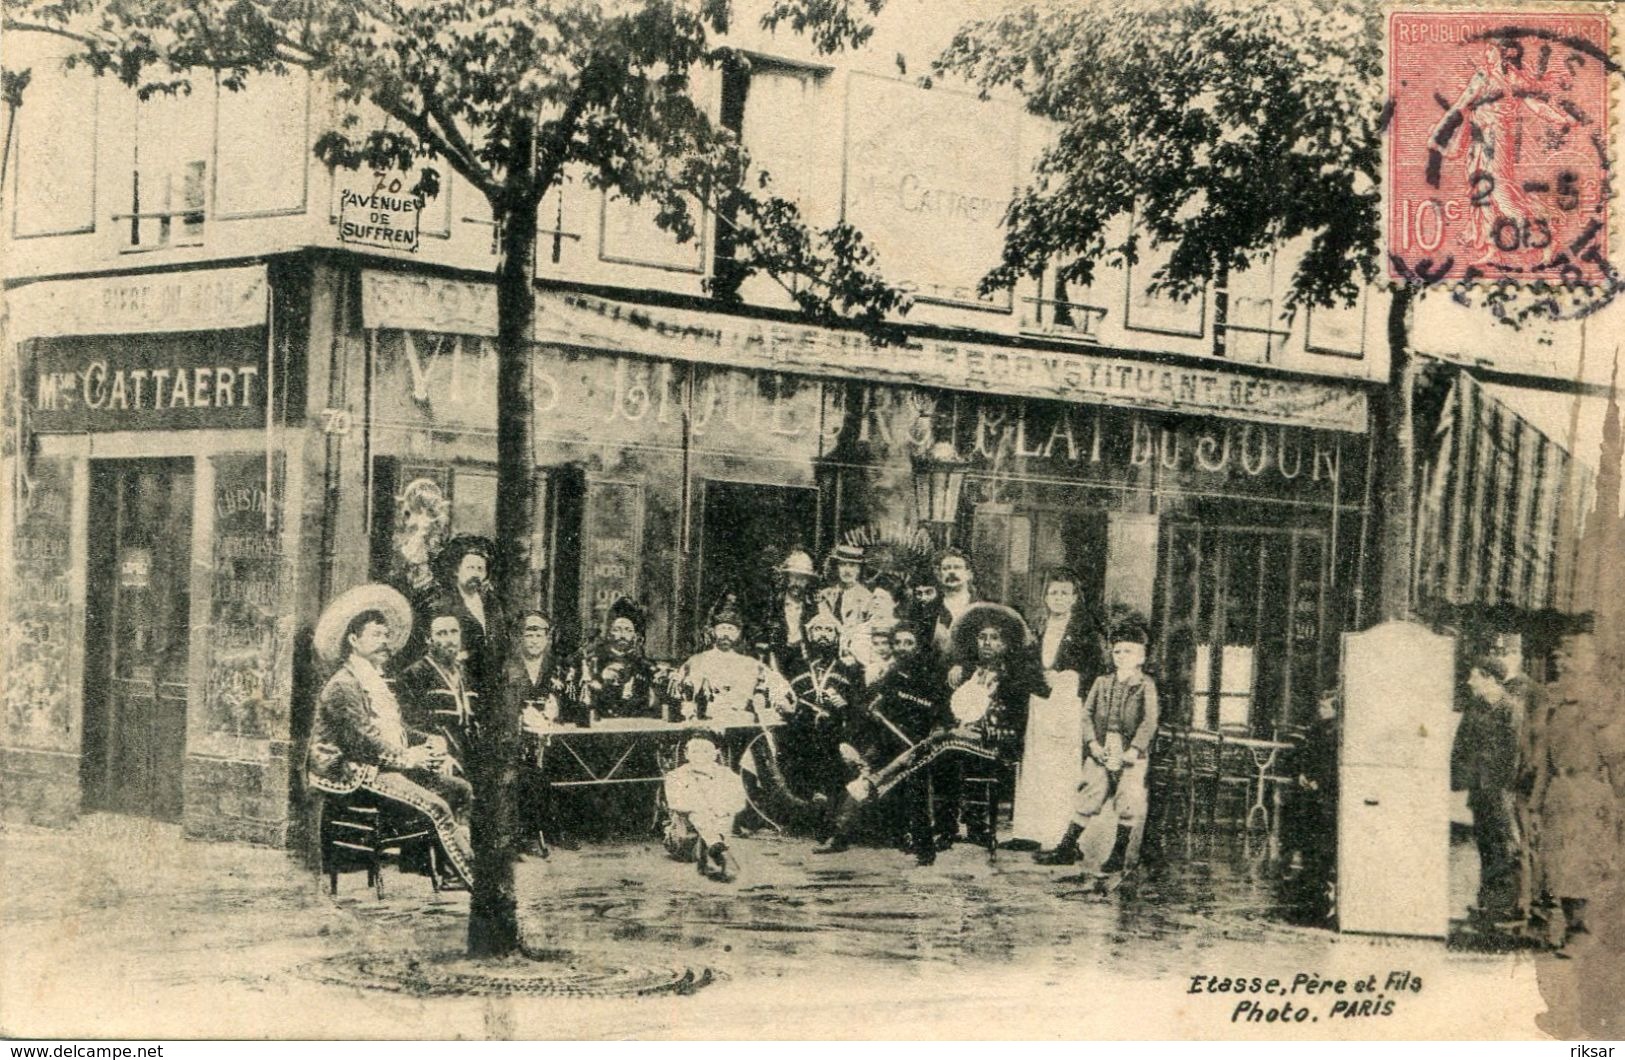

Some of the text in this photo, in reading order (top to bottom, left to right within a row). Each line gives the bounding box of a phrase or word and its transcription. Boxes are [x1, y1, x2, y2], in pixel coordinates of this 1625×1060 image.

[347, 193, 414, 212] AVENUE
[370, 212, 391, 225] DE
[342, 222, 415, 244] SUFFREN
[83, 359, 258, 409] CATTAERT
